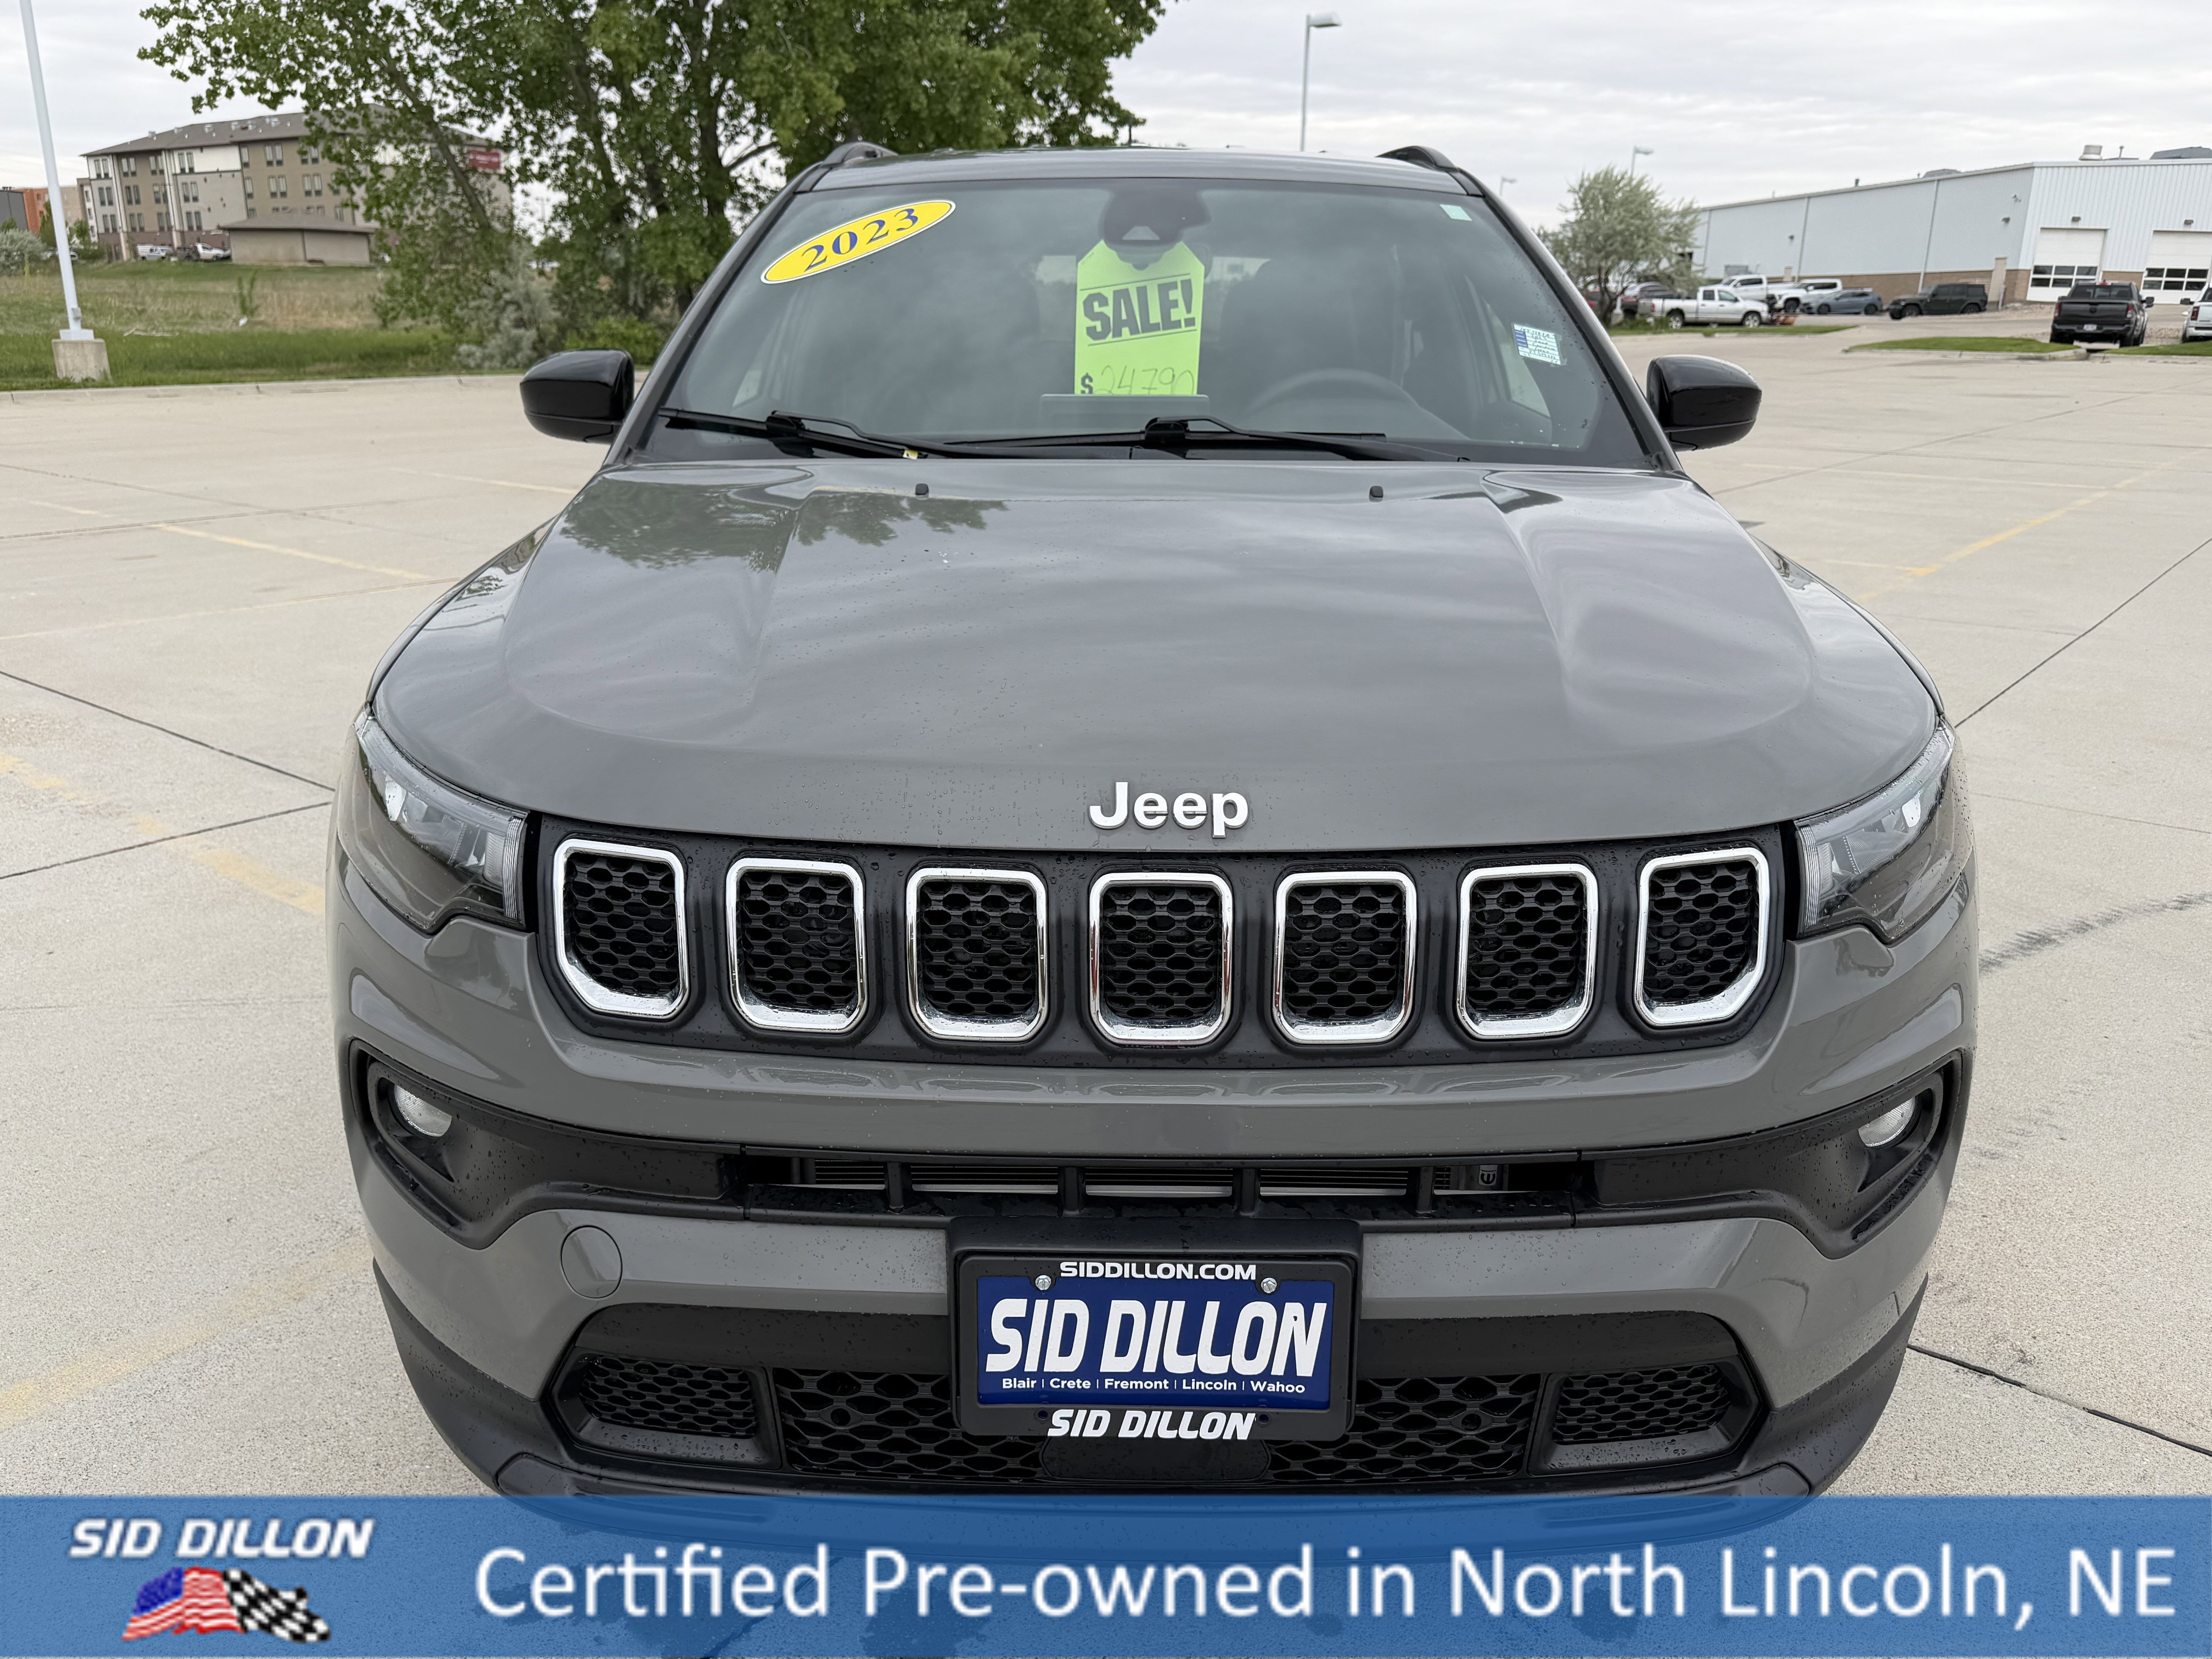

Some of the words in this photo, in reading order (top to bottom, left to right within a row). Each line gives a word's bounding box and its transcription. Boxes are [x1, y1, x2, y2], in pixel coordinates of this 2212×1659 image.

[801, 208, 919, 273] 2023
[1082, 278, 1197, 341] SALE!
[1089, 781, 1249, 839] Jeep
[1060, 1261, 1257, 1280] SIDDILLON.COM
[985, 1298, 1090, 1372] SID
[1099, 1299, 1328, 1377] DILLON
[1002, 1377, 1037, 1389] Blair
[1049, 1377, 1091, 1389] Crete
[1104, 1378, 1170, 1390] Fremont
[1182, 1379, 1237, 1391] Lincoln
[1250, 1381, 1305, 1393] Wahoo
[1047, 1409, 1111, 1437] SID
[1118, 1410, 1256, 1440] DILLON
